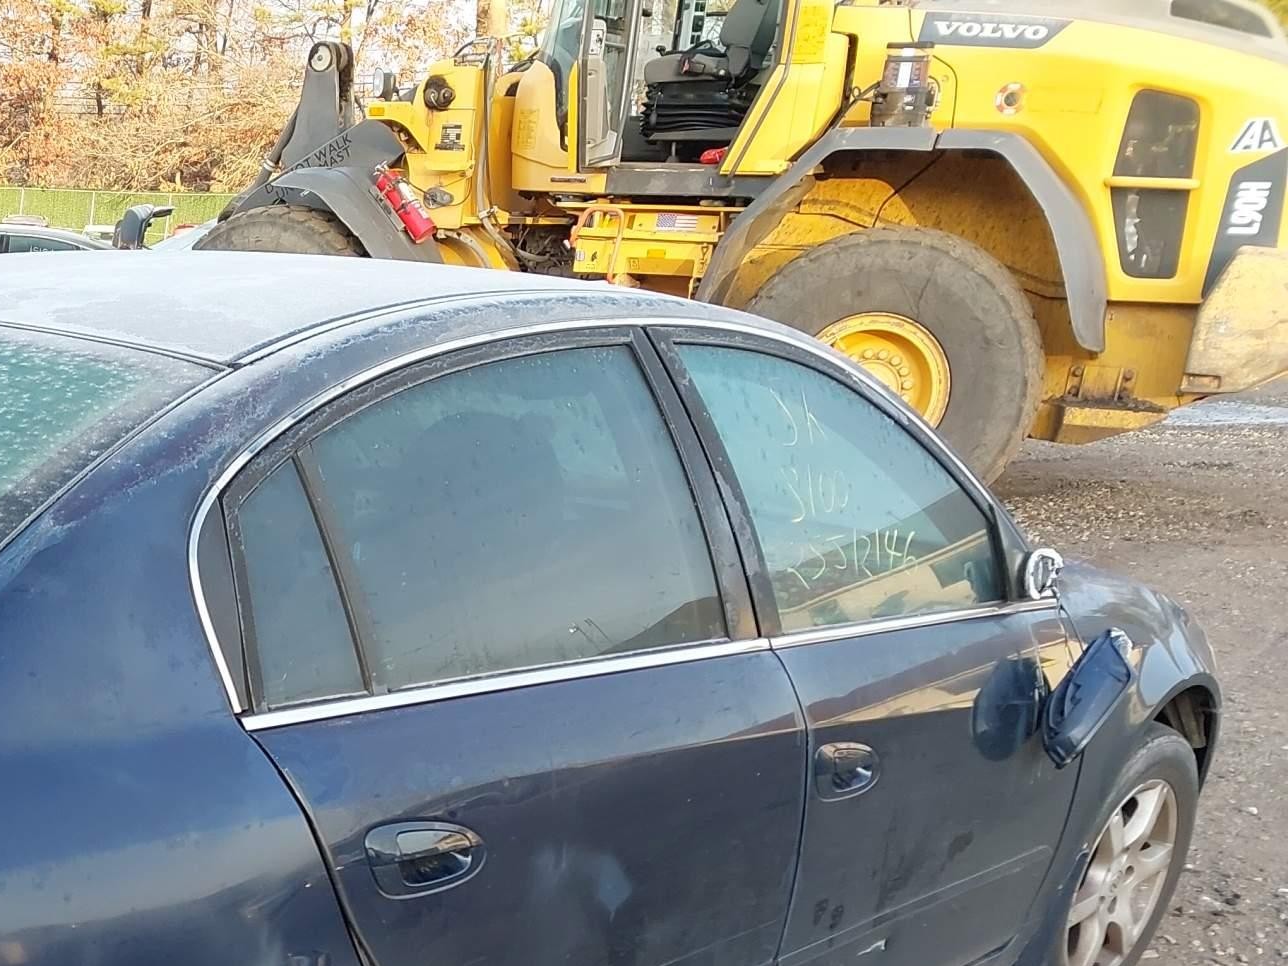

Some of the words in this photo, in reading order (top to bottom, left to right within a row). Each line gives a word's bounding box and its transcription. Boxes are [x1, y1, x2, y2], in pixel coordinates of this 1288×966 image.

[933, 21, 1049, 40] VOLVO
[314, 133, 352, 161] WALK
[1226, 181, 1272, 234] L90H
